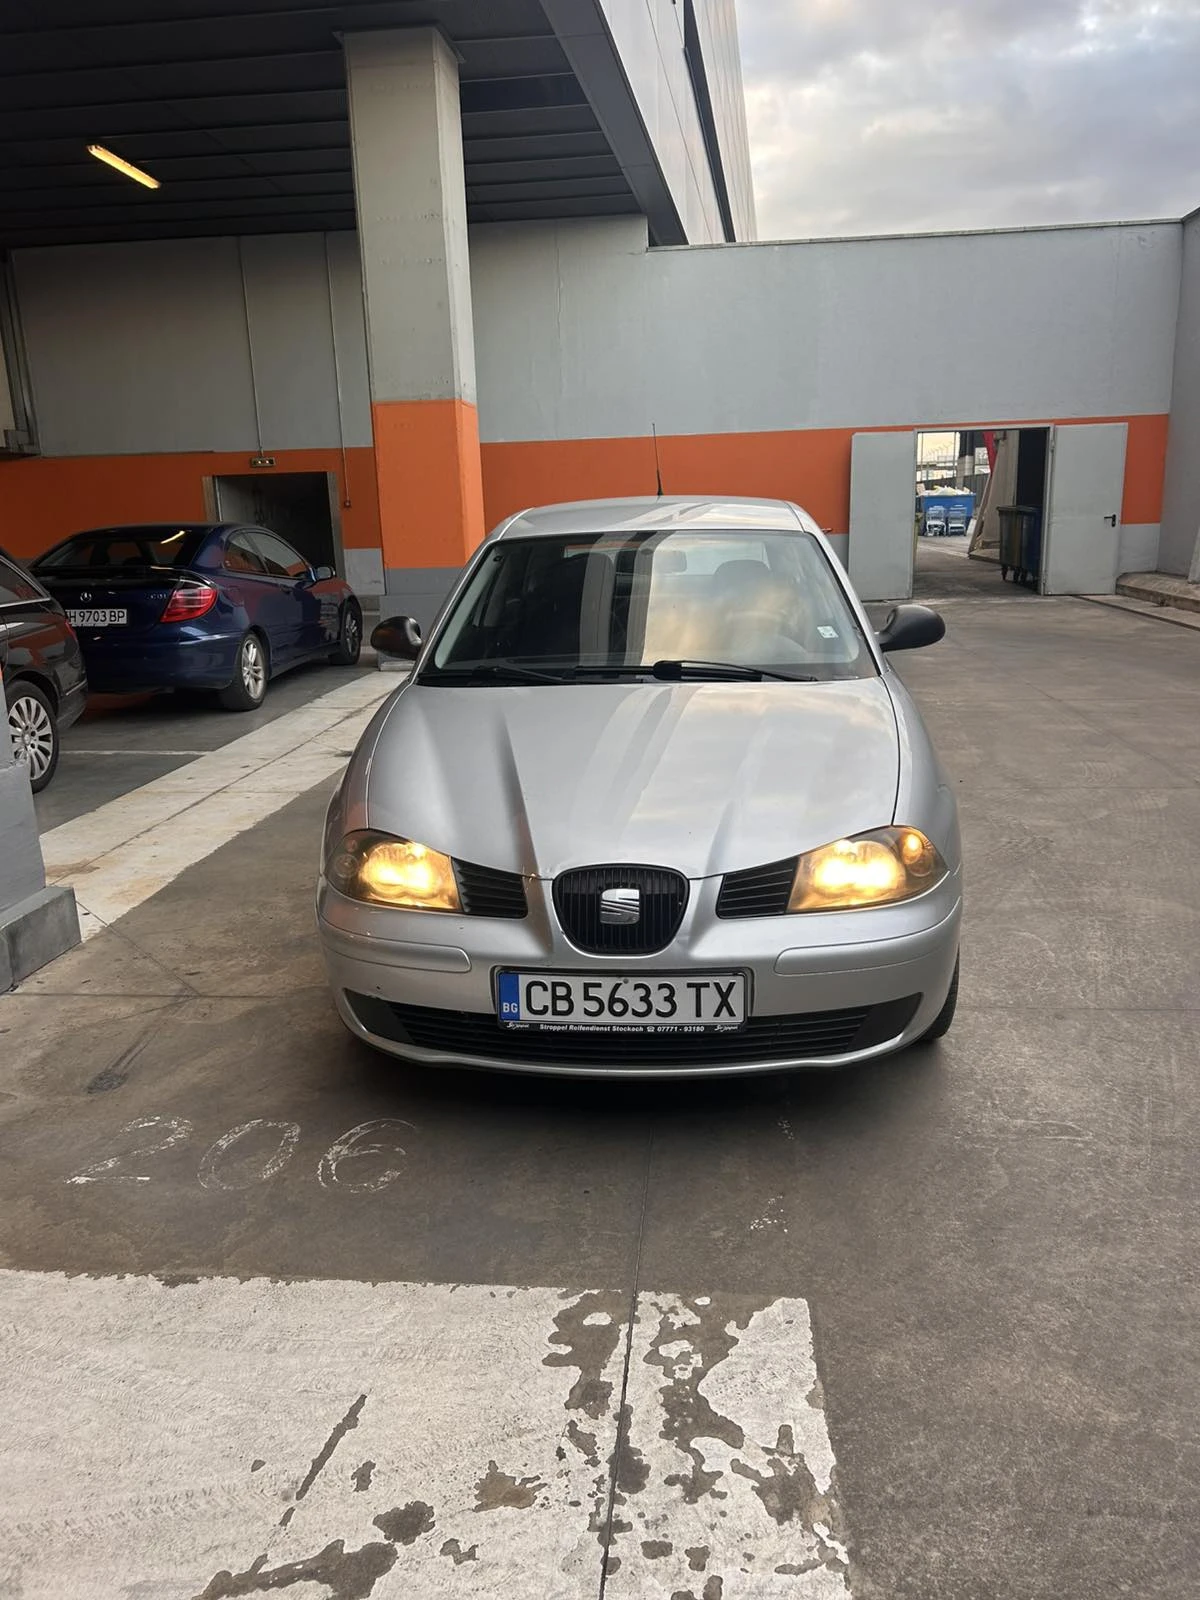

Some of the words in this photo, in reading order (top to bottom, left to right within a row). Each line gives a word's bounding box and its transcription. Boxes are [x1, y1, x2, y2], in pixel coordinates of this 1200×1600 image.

[79, 611, 107, 622] 9703
[109, 611, 125, 622] BP
[526, 980, 574, 1016] CB
[583, 982, 678, 1018] 5633
[686, 982, 736, 1018] TX
[503, 1002, 518, 1013] BG
